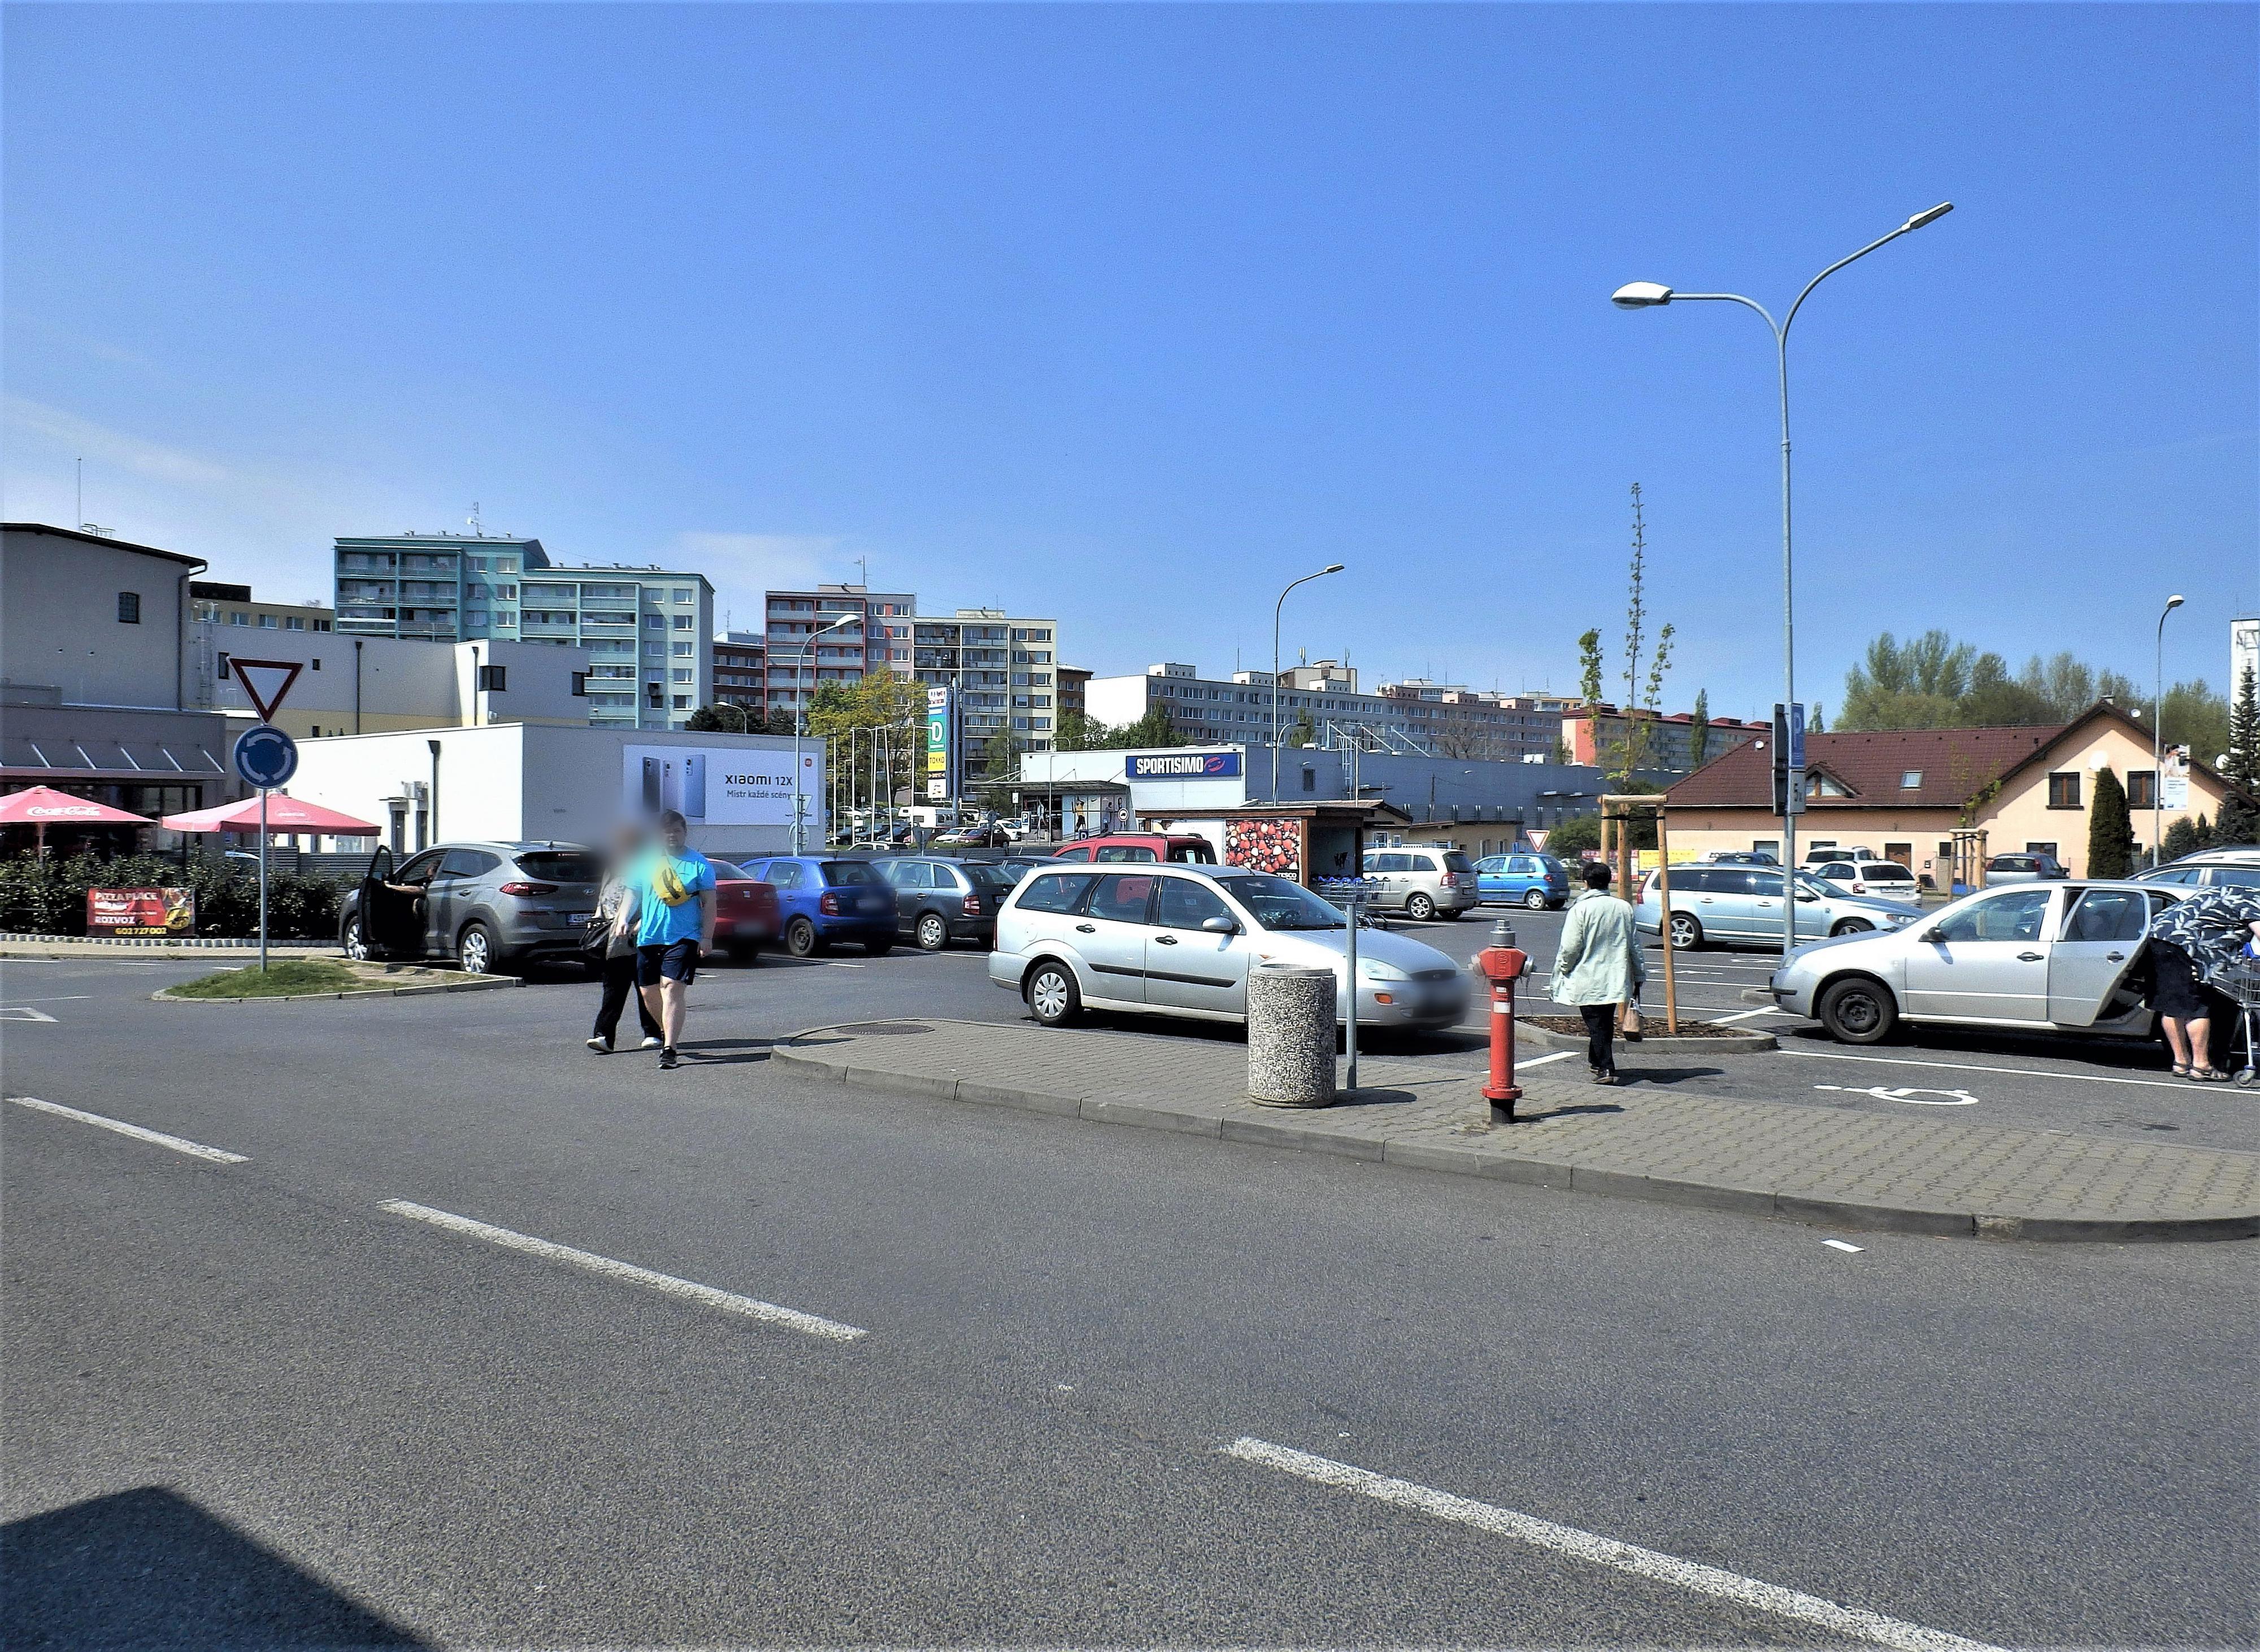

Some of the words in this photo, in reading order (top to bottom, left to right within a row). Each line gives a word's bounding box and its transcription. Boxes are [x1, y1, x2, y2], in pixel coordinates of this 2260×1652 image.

[932, 721, 944, 742] D
[1136, 756, 1204, 775] SPORTISIMO
[775, 776, 793, 786] 12X
[748, 790, 769, 798] každé
[771, 790, 790, 799] scény
[1023, 814, 1028, 823] P
[95, 916, 136, 924] ROZVOZ
